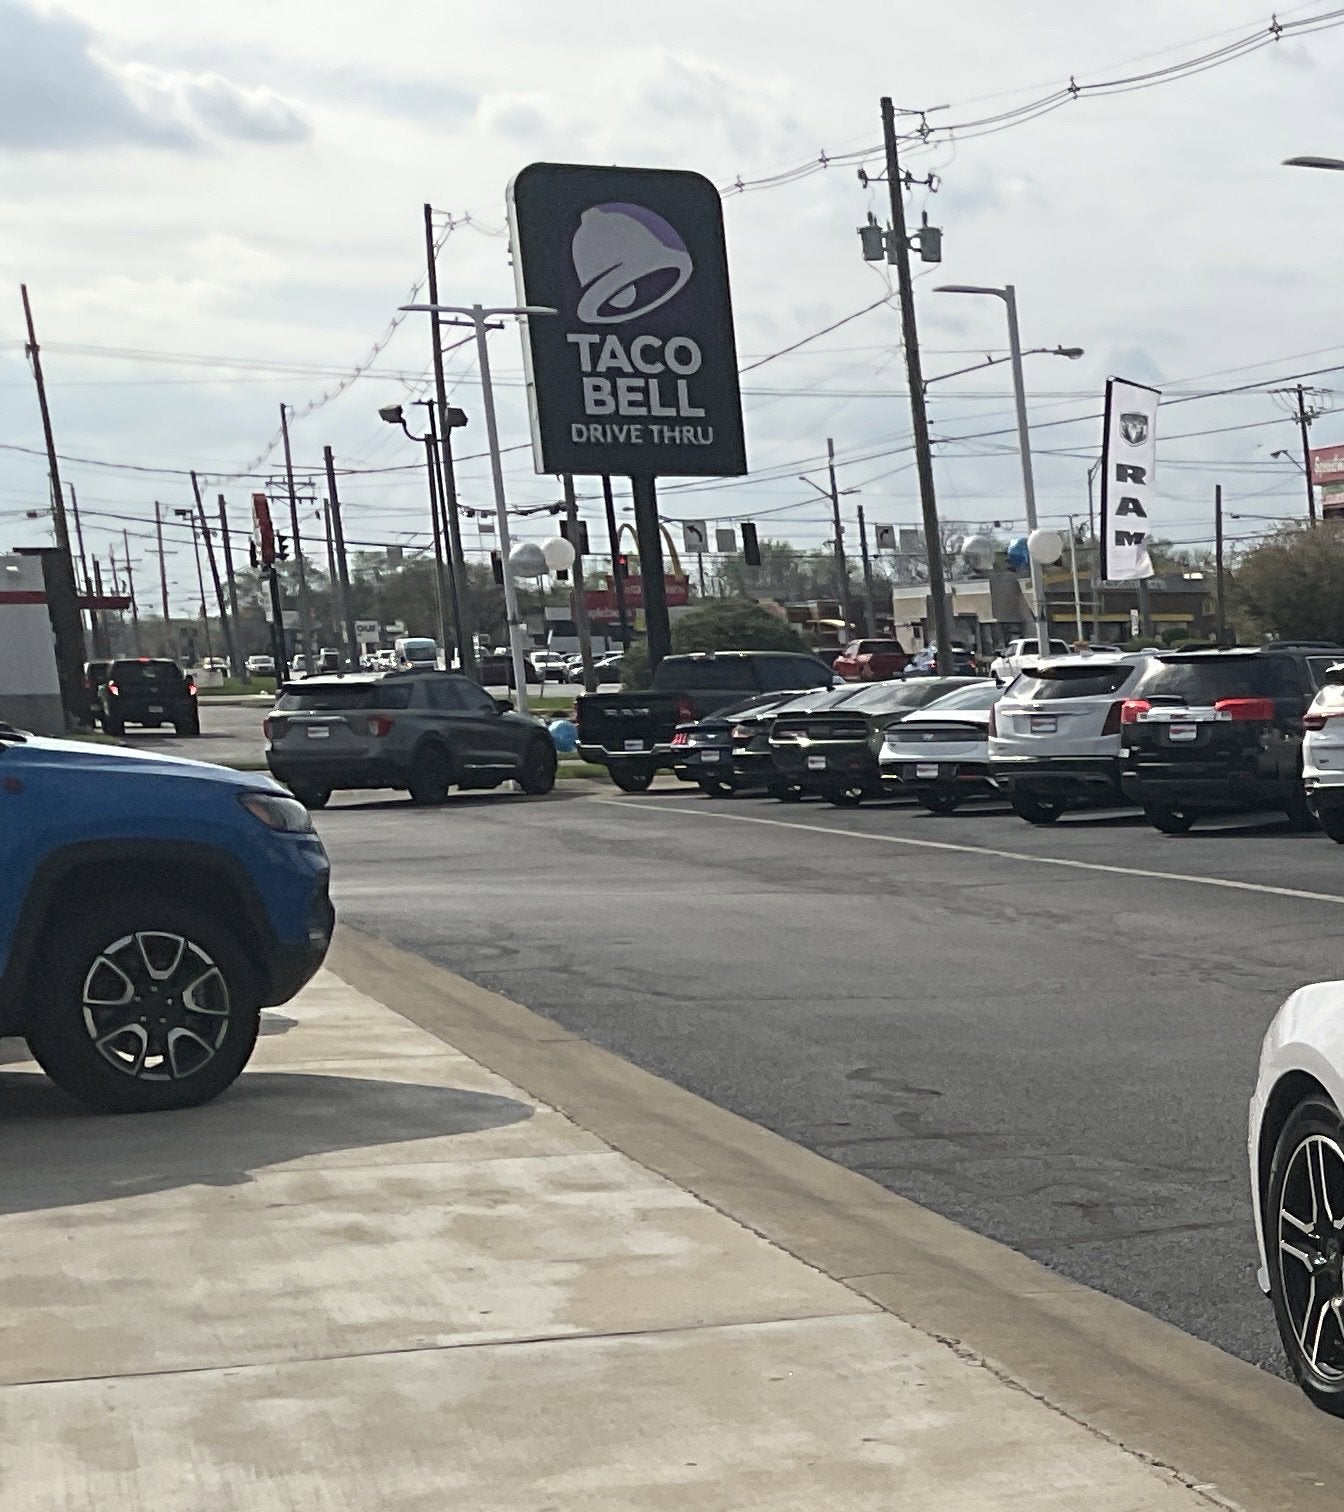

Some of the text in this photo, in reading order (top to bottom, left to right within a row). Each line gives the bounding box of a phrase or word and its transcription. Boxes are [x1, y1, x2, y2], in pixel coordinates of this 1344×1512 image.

[566, 333, 702, 375] TACO
[582, 377, 706, 418] BELL
[571, 424, 714, 445] DRIVE THRU
[1115, 463, 1147, 546] RAM
